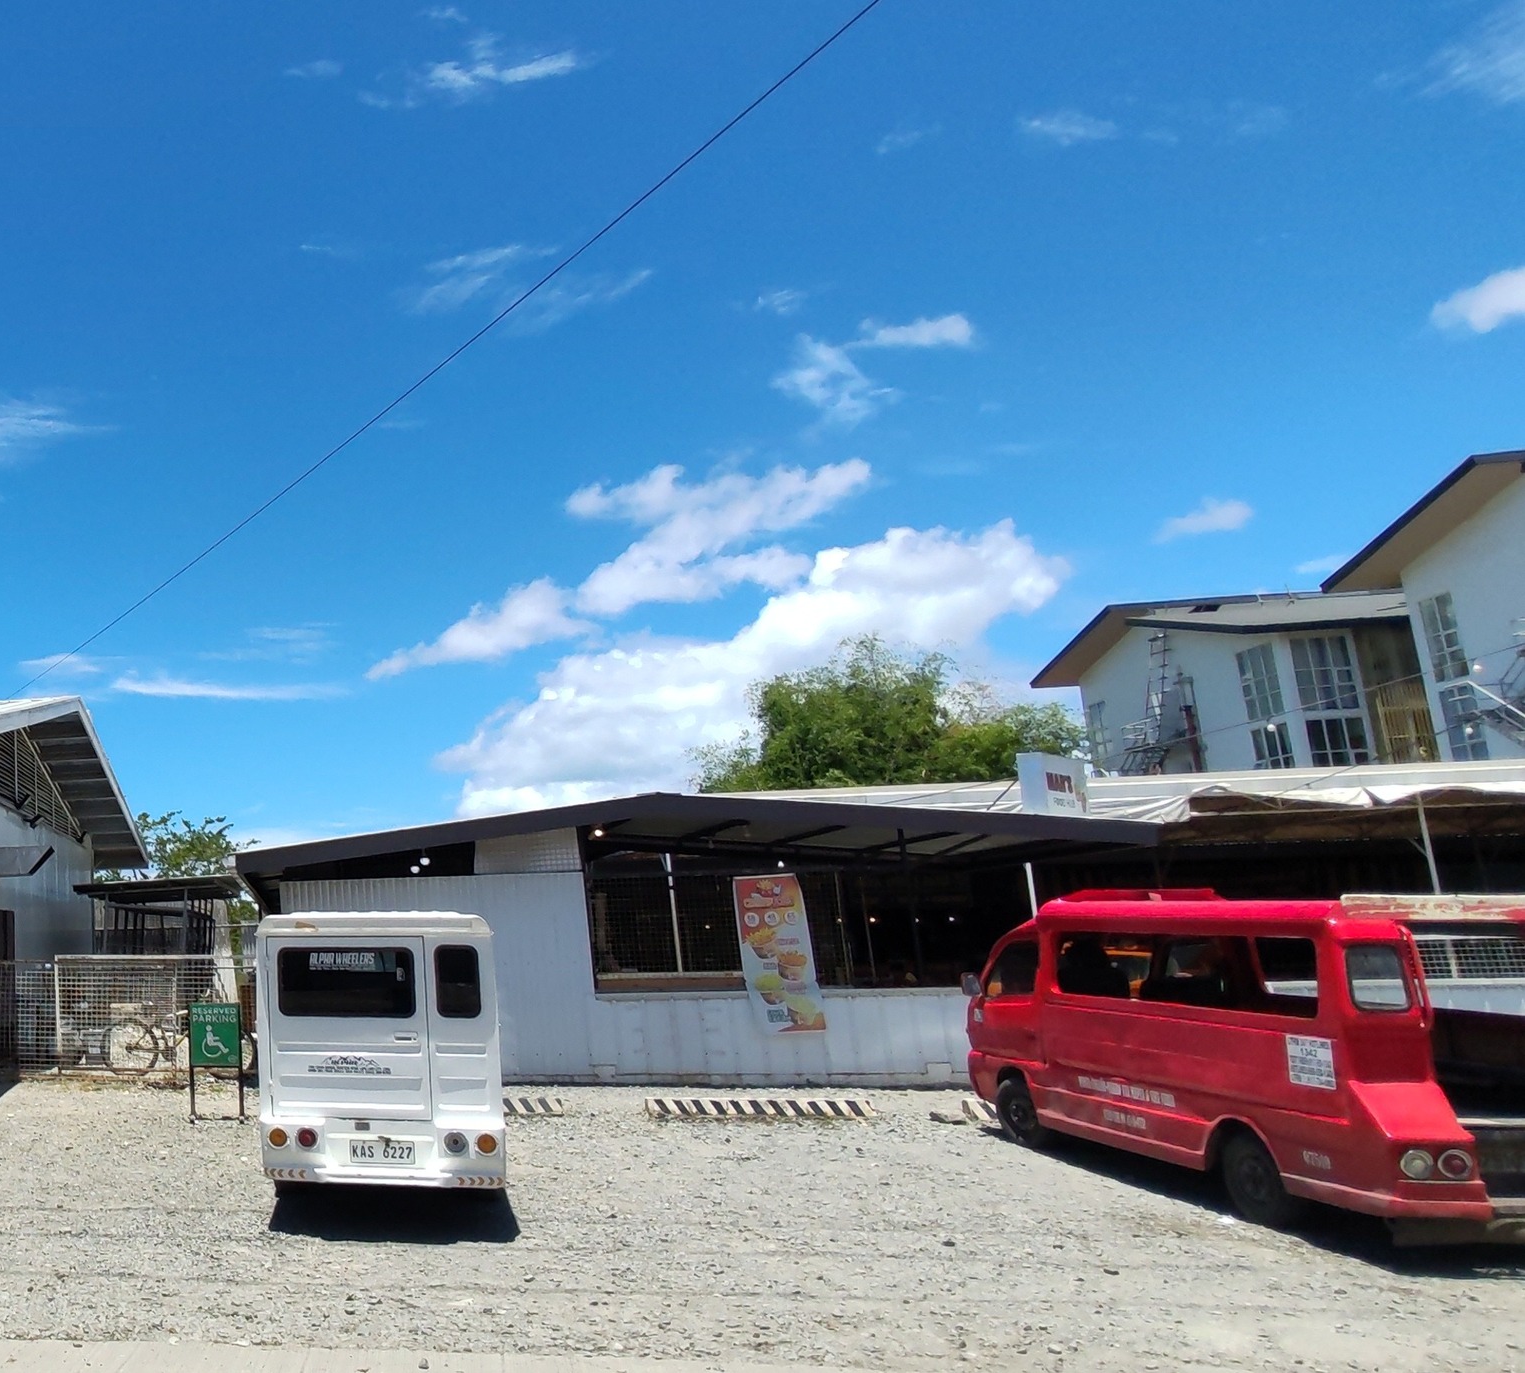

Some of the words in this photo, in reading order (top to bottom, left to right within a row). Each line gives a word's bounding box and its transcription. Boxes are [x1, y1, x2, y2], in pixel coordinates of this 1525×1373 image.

[191, 1007, 237, 1015] RESERVED
[192, 1014, 237, 1023] PARKING
[352, 1145, 374, 1159] KAS
[382, 1145, 413, 1160] 6227
